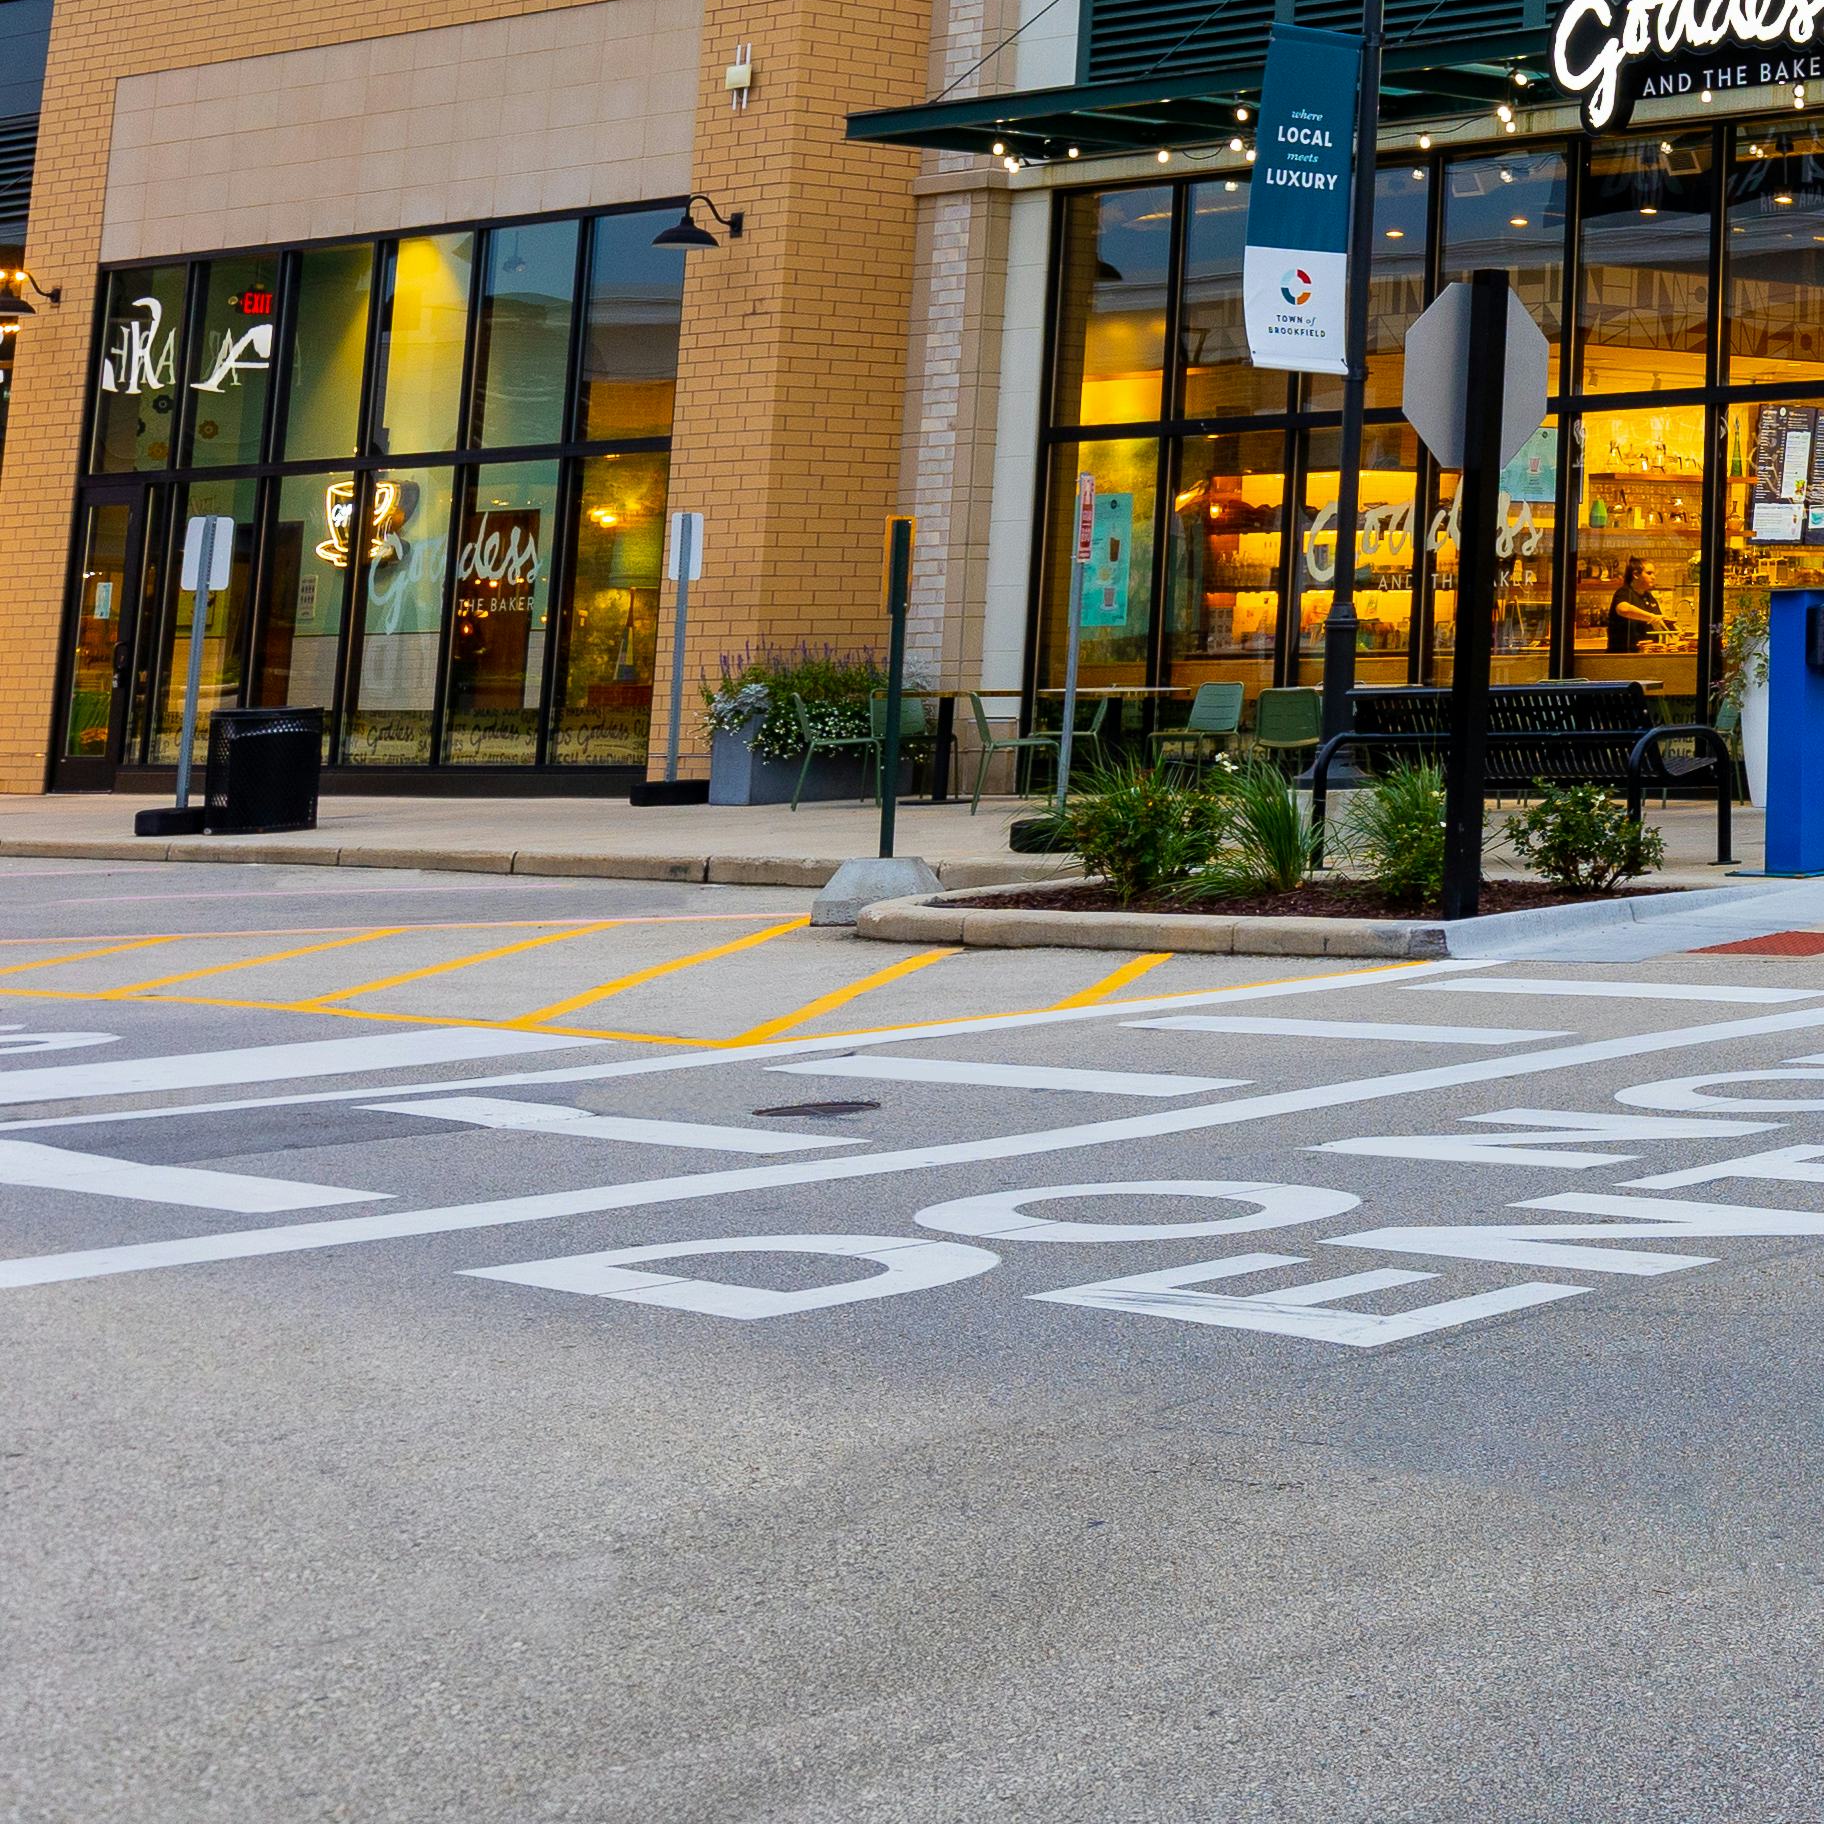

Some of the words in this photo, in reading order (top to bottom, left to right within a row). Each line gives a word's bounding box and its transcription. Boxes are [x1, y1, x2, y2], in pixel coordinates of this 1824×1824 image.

[1643, 74, 1691, 97] AND
[1703, 65, 1748, 89] THE
[1291, 108, 1324, 122] where
[1277, 125, 1334, 148] LOCAL
[1287, 152, 1319, 163] meets
[1266, 168, 1338, 191] LUXURY
[243, 292, 273, 315] EXIT
[1276, 314, 1303, 325] TOWN
[1306, 316, 1318, 327] of
[1268, 326, 1326, 338] BROOKFIELD
[1432, 573, 1453, 589] TH
[1493, 570, 1534, 588] KER
[459, 599, 483, 612] THE
[491, 596, 535, 613] BAKER
[459, 1179, 1362, 1319] DO
